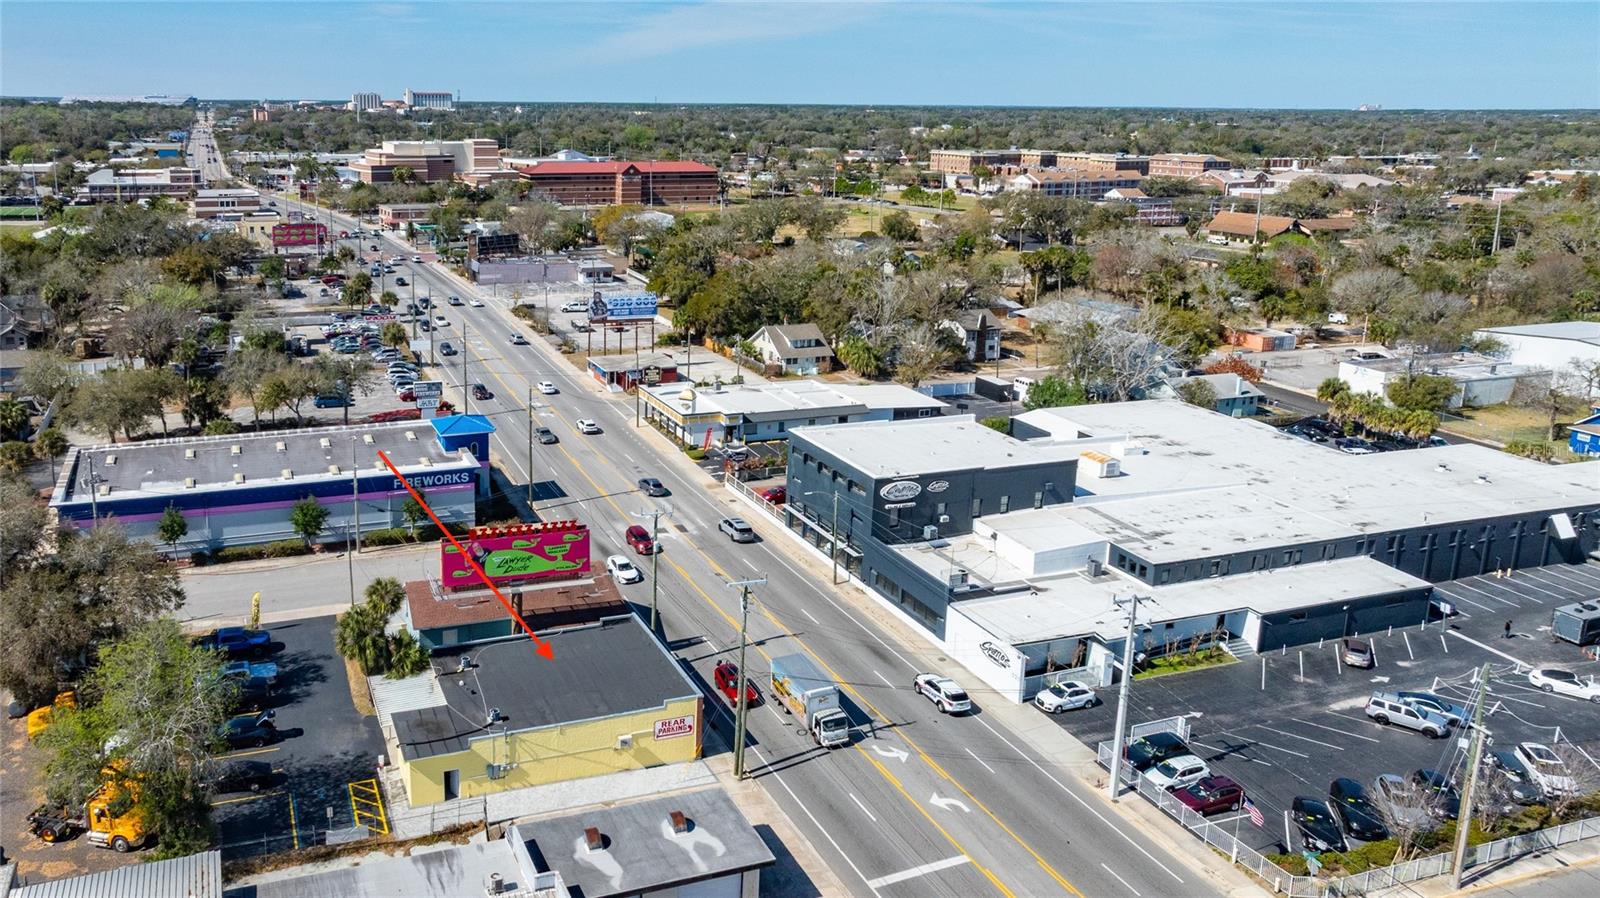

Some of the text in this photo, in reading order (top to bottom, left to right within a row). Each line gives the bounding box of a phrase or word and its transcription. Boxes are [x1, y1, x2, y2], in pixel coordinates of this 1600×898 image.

[496, 555, 533, 569] LAWYER
[661, 718, 686, 728] REAR
[658, 724, 688, 735] PARKING
